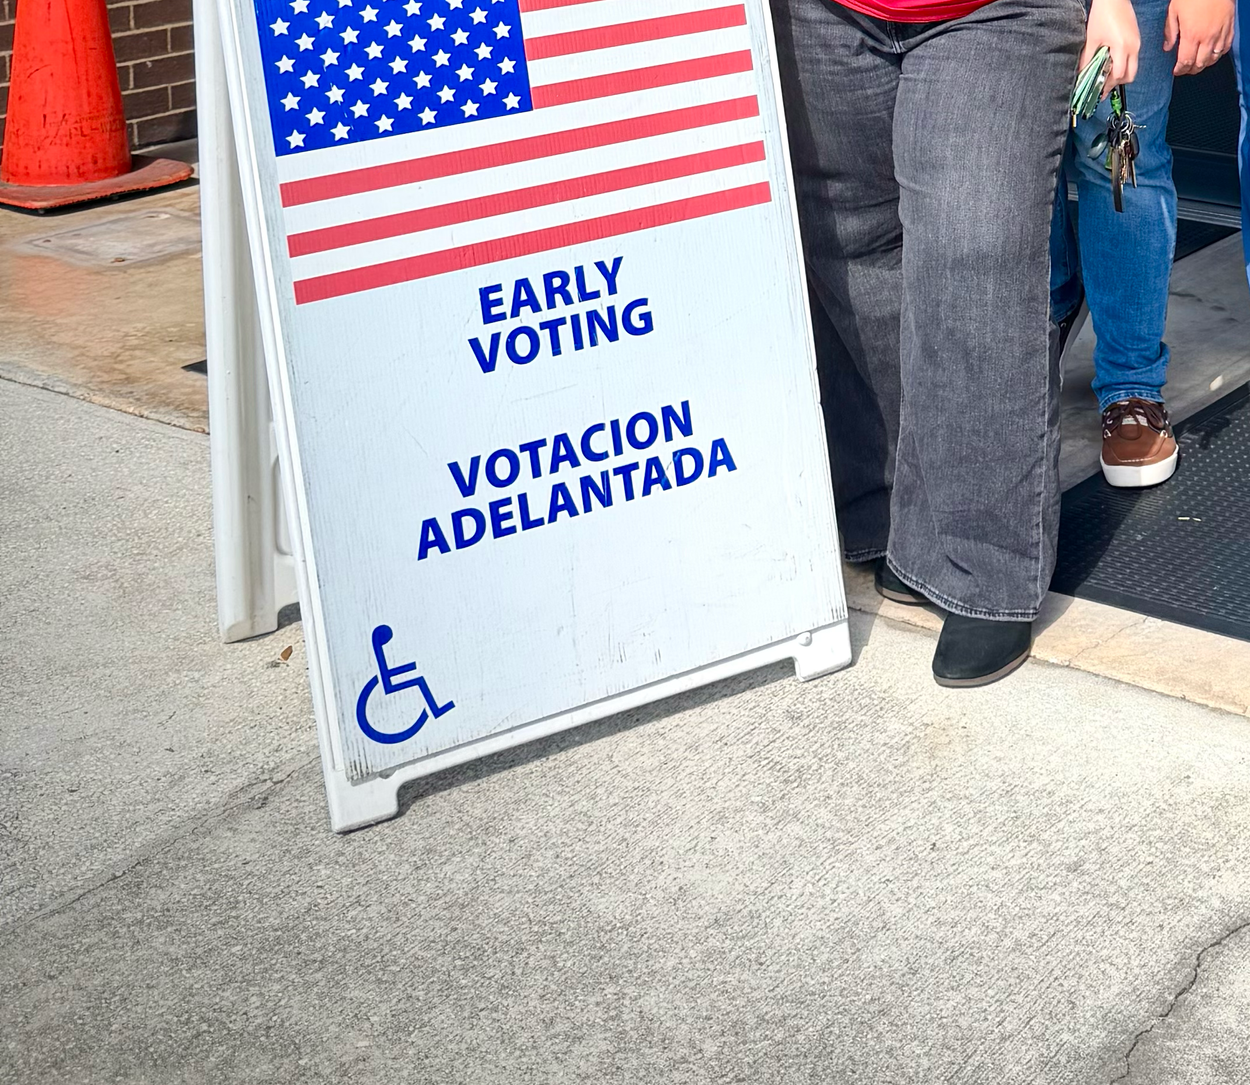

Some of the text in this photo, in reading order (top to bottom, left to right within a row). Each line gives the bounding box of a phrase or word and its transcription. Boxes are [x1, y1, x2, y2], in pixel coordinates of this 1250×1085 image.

[478, 256, 624, 326] EARLY
[467, 297, 655, 374] VOTING
[446, 399, 694, 499] VOTACION
[417, 437, 738, 562] ADELANTADA
